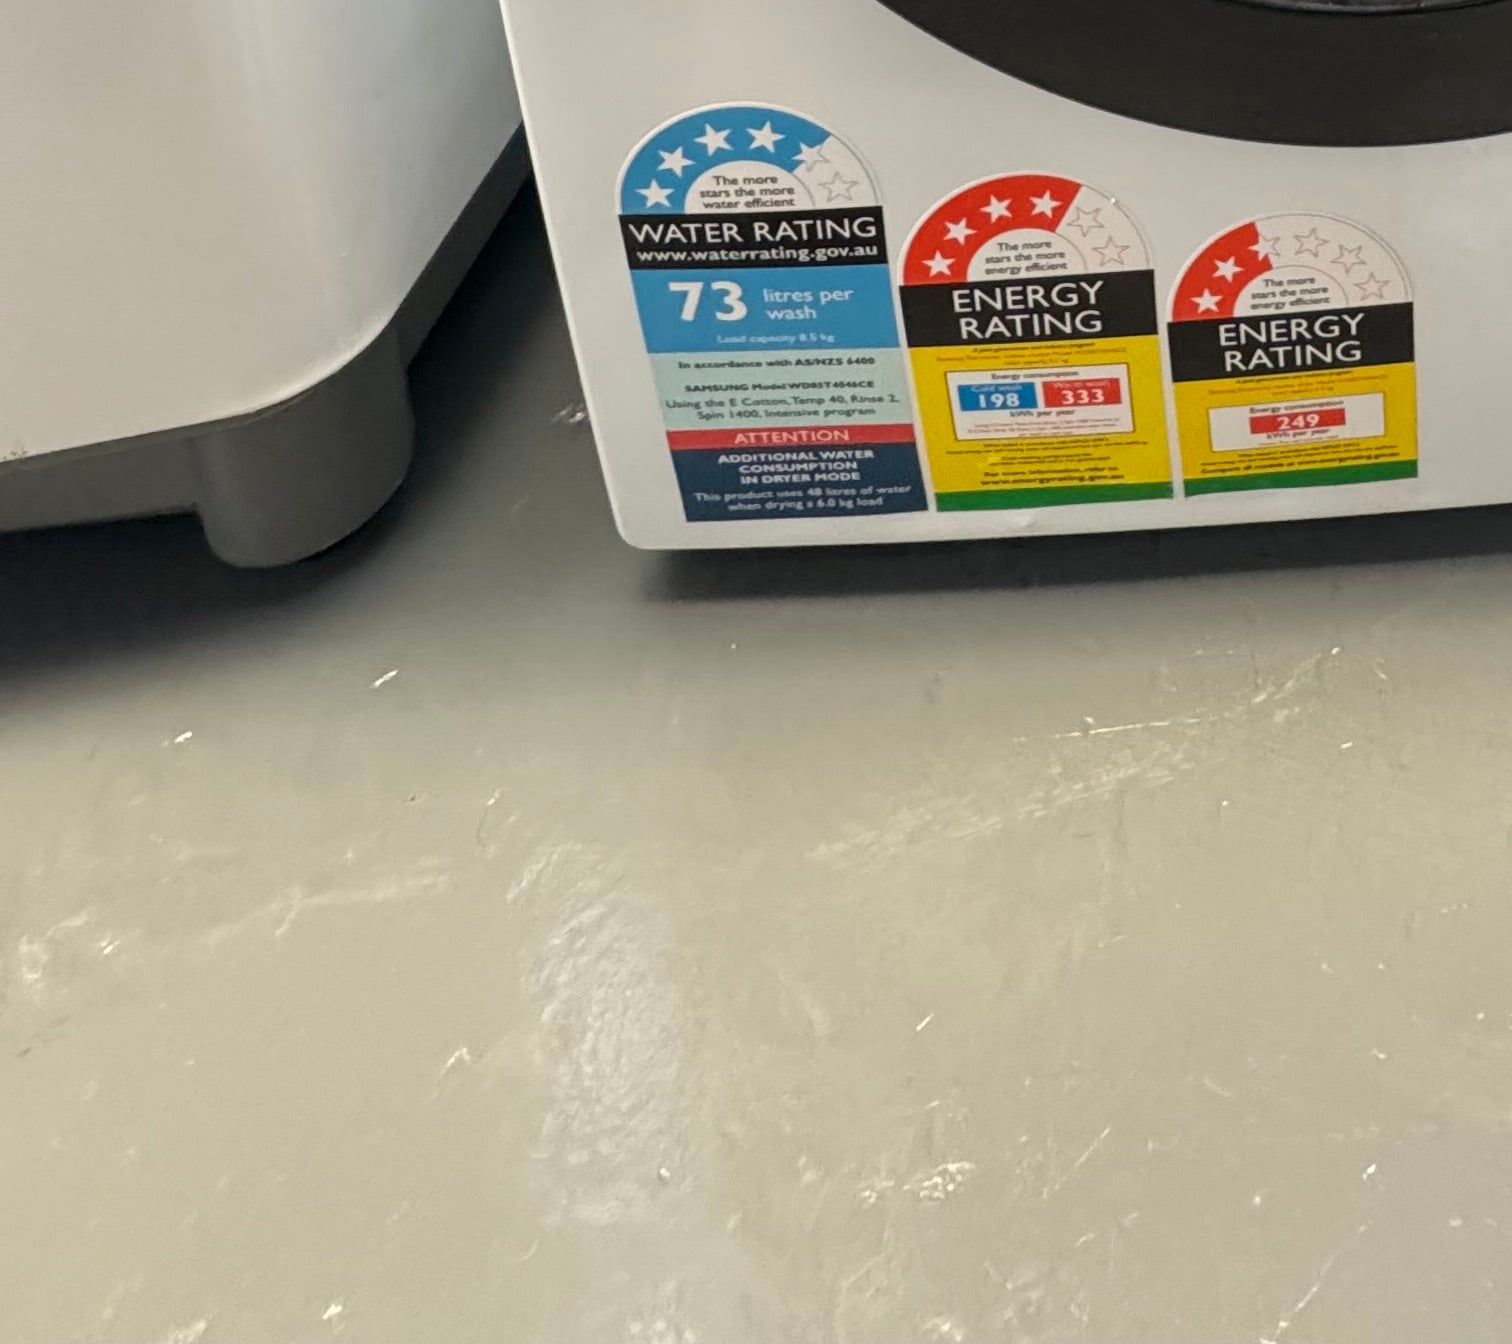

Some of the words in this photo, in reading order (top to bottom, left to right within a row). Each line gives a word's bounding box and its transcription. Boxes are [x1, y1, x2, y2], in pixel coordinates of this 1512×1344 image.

[713, 175, 740, 186] The
[743, 175, 778, 185] more
[700, 188, 731, 198] stars
[734, 187, 756, 197] the
[760, 187, 795, 196] more
[703, 199, 741, 209] water
[745, 197, 795, 208] efficient
[628, 221, 744, 244] WATER
[753, 216, 877, 242] RATING
[636, 244, 878, 263] www.waterrating.gov.au
[997, 242, 1019, 252] The
[667, 280, 749, 323] 73
[763, 288, 814, 303] litres
[819, 288, 855, 305] per
[952, 280, 1104, 313] ENERGY
[765, 305, 817, 321] wash
[959, 310, 1103, 340] RATING
[1218, 312, 1365, 347] ENERGY
[1224, 340, 1362, 372] RATING
[665, 399, 701, 410] Using
[704, 398, 725, 408] the
[792, 396, 825, 407] Temp
[978, 392, 1020, 409] 198
[1061, 388, 1105, 406] 333
[697, 410, 724, 422] Spin
[1276, 413, 1320, 431] 249
[733, 429, 850, 445] ATTENTION
[717, 452, 817, 464] ADDITIONAL
[819, 450, 874, 460] WATER
[738, 461, 858, 474] CONSUMPTION
[739, 475, 758, 485] IN
[761, 473, 811, 484] DRYER
[814, 471, 860, 482] MODE
[694, 491, 721, 502] This
[724, 489, 774, 502] product
[876, 484, 912, 494] water
[728, 501, 762, 512] when
[765, 500, 804, 512] drying
